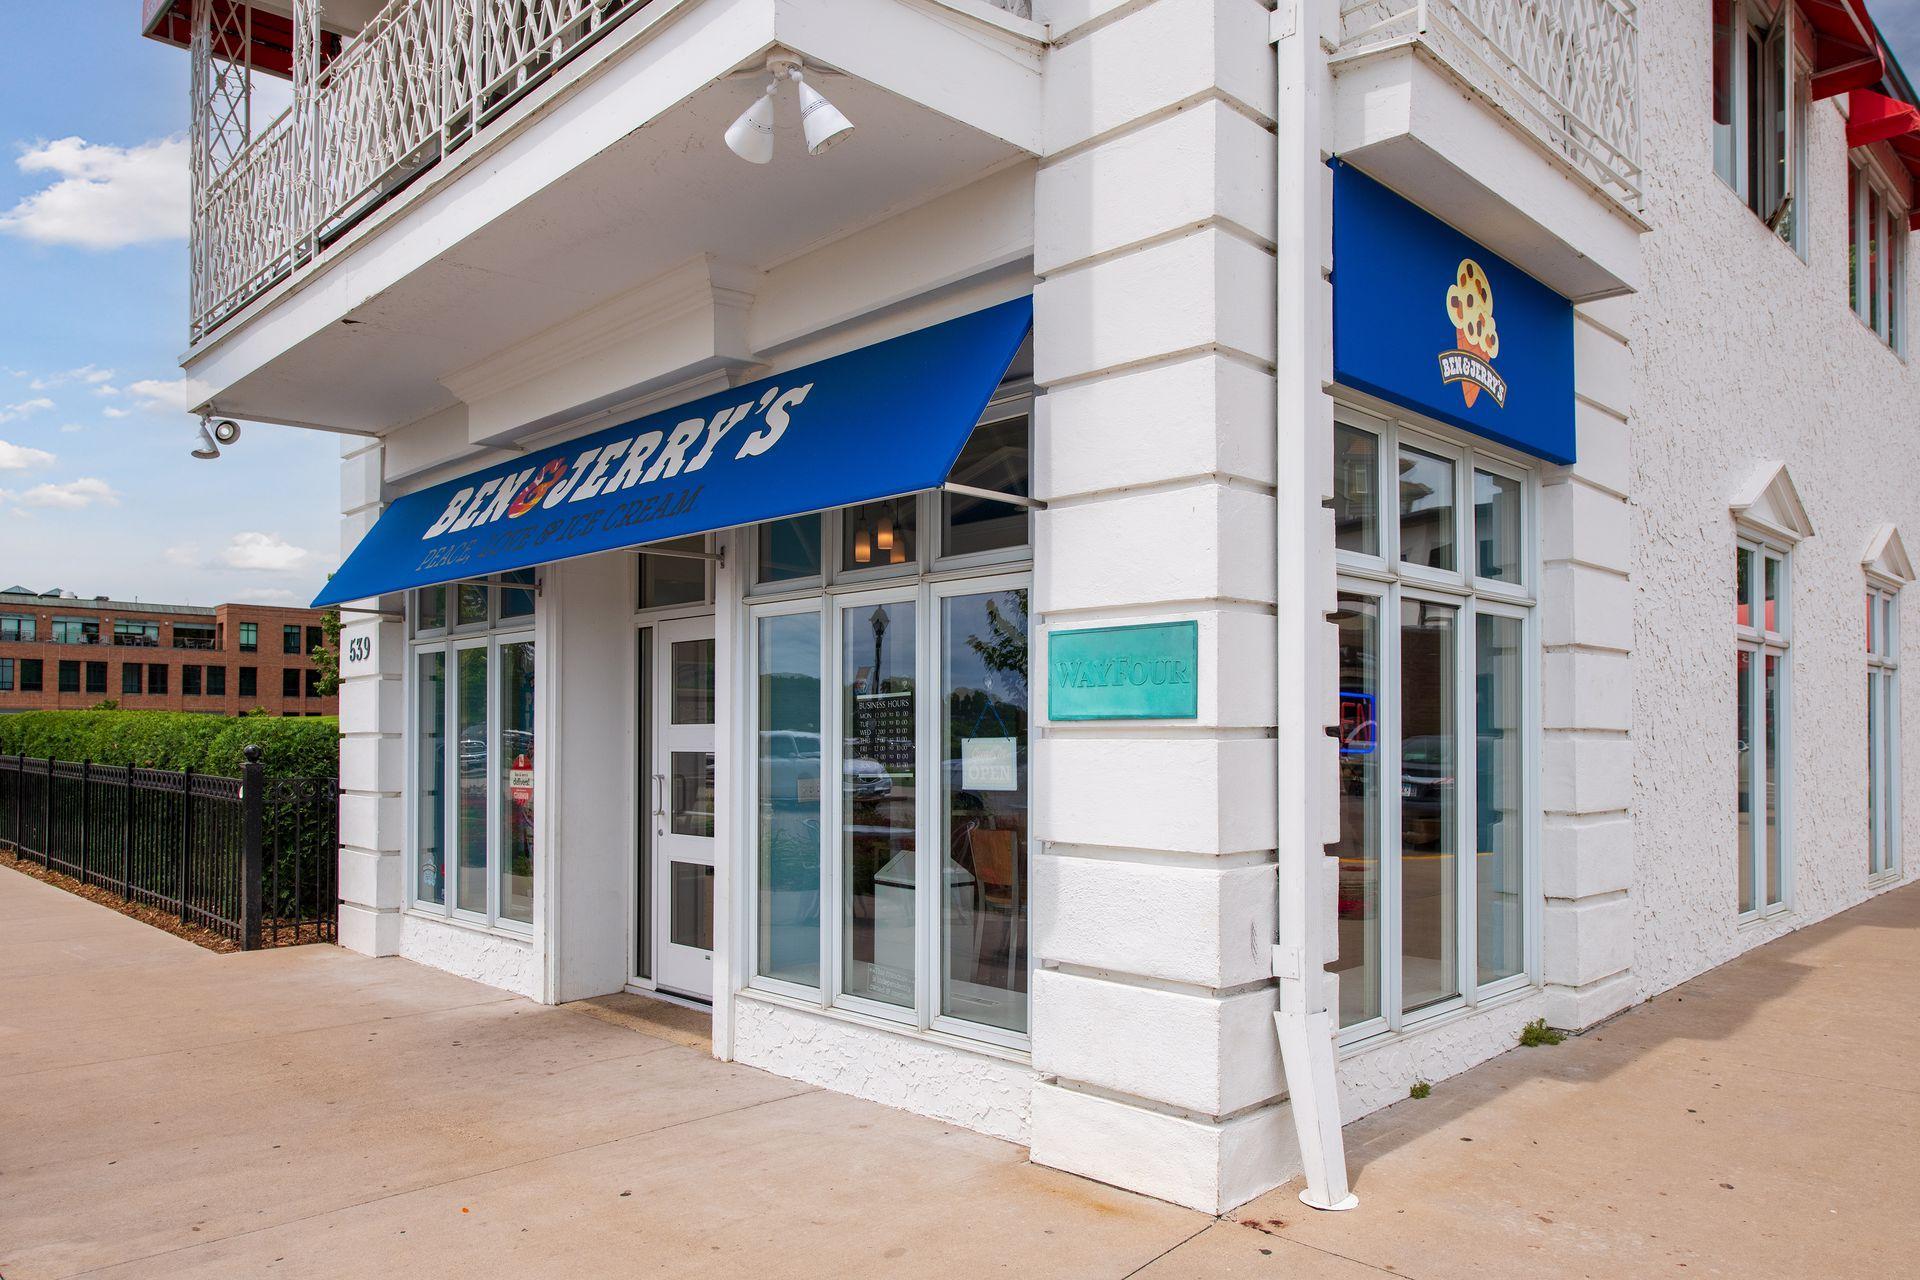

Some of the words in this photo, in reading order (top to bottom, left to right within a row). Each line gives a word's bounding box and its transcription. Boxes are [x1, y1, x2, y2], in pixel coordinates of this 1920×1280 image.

[1442, 356, 1462, 377] BEN
[1462, 357, 1470, 375] &
[1470, 359, 1504, 402] JERRY'S
[422, 467, 538, 540] BEN
[508, 456, 569, 519] &
[543, 383, 814, 509] JERRY'S
[557, 508, 604, 542] ICE
[350, 636, 371, 662] 539
[1055, 655, 1190, 689] WAYFOUR
[859, 701, 886, 709] BUSINESS
[887, 699, 910, 708] HOURS
[859, 745, 868, 753] FRI
[968, 765, 1011, 781] OPEN
